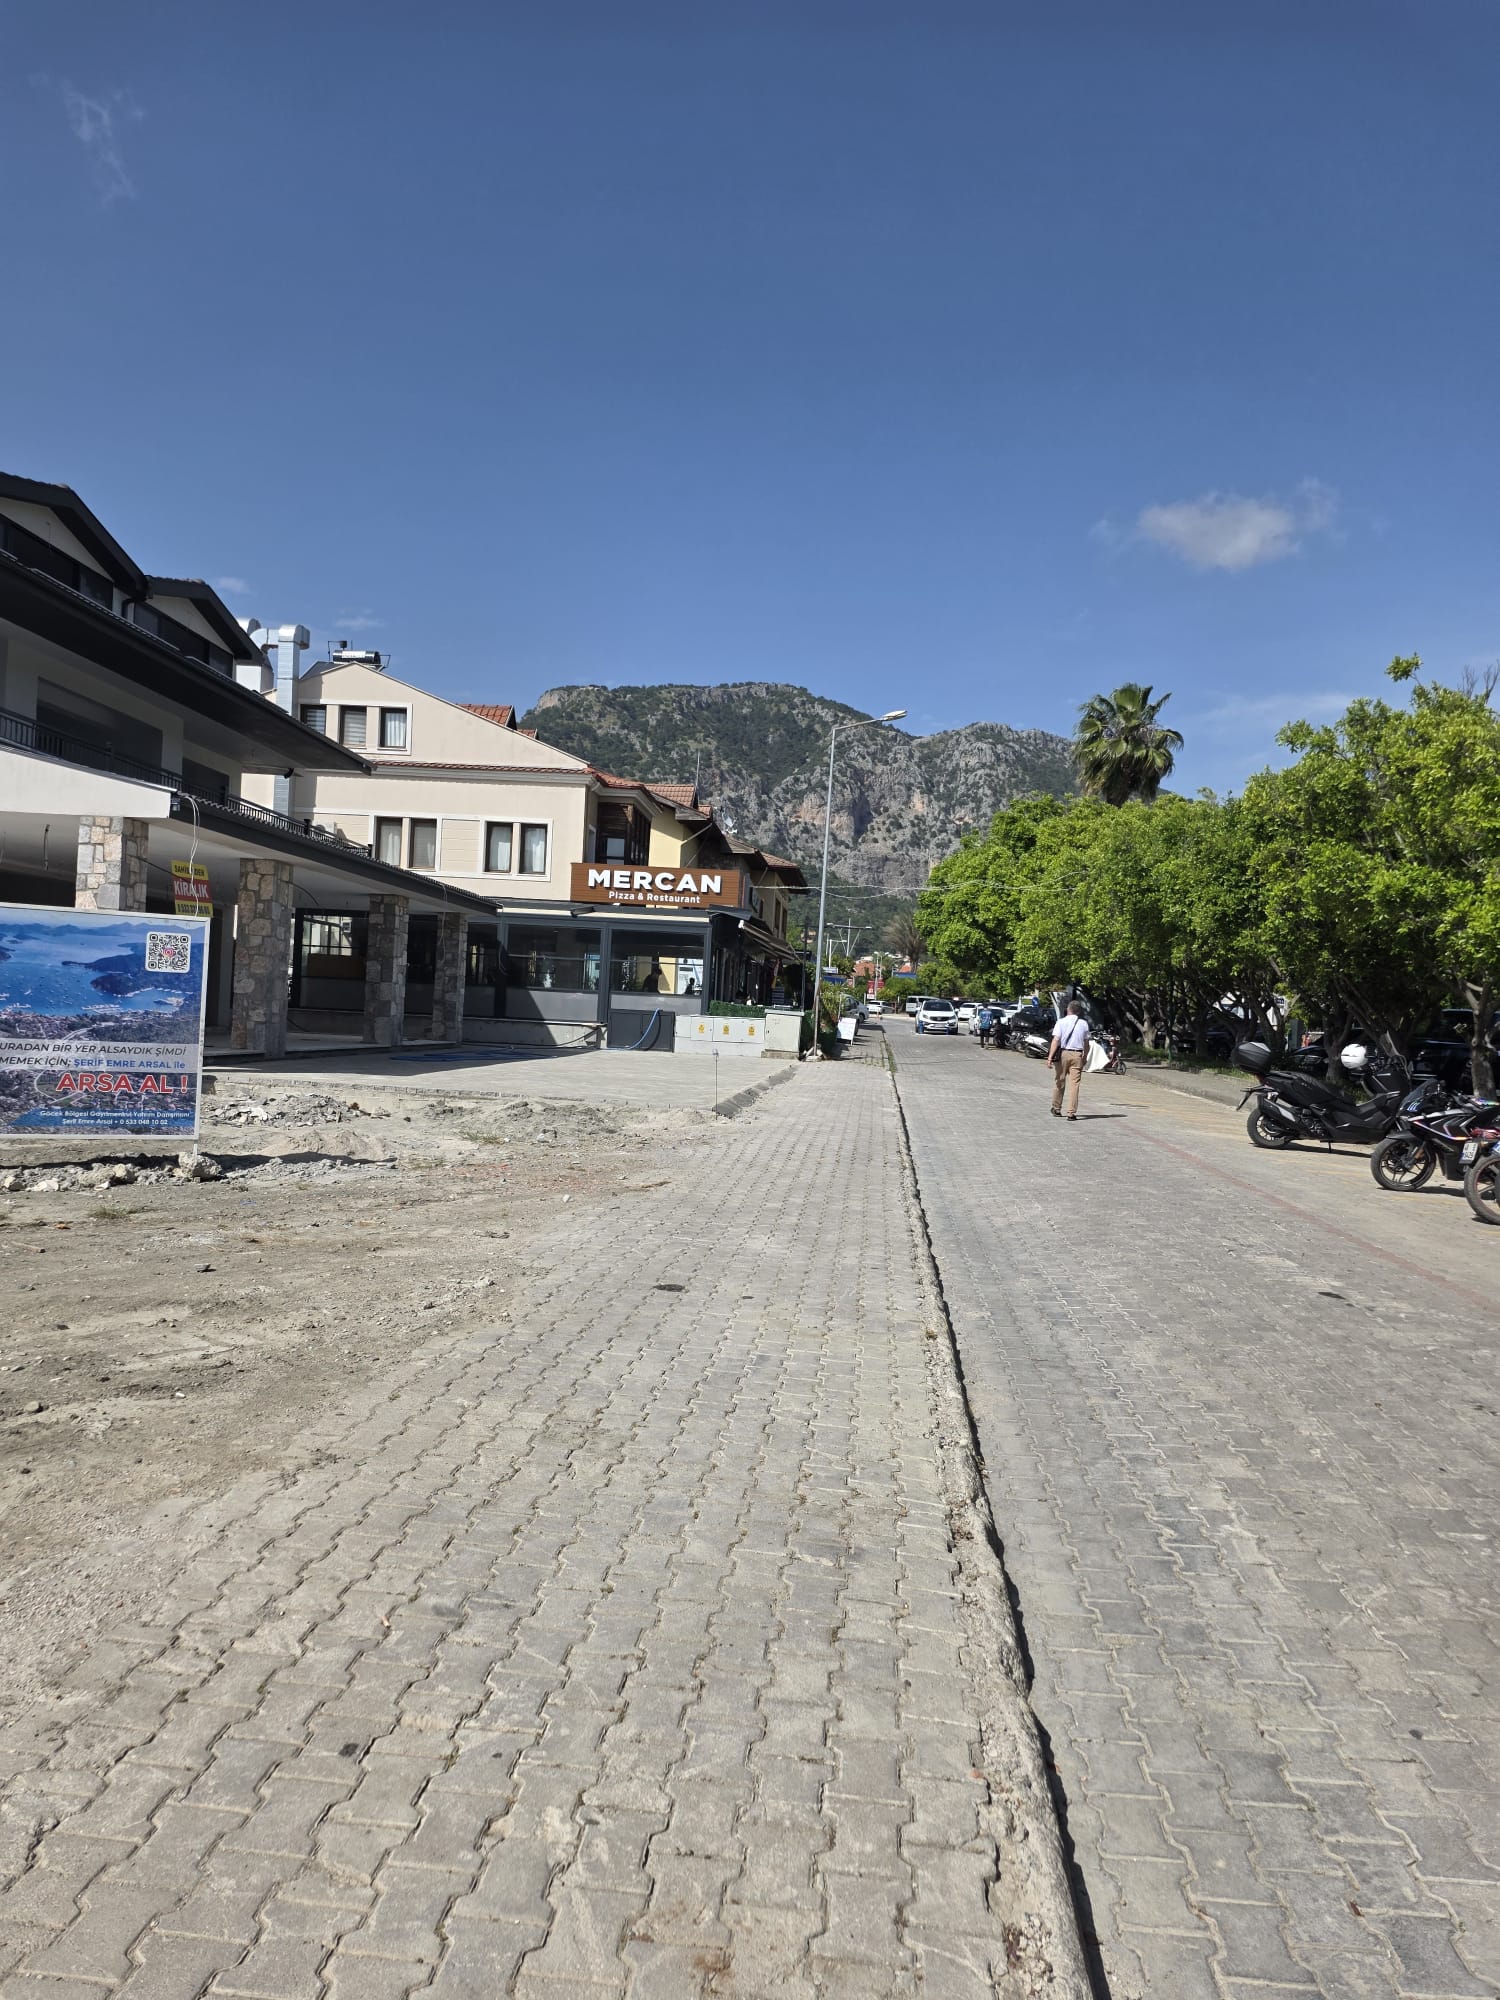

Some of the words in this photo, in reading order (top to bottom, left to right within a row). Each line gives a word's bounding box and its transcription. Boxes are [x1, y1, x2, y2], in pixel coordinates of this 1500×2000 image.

[174, 879, 209, 898] KİRALIK
[587, 868, 722, 894] MERCAN
[608, 890, 635, 900] Pizza
[637, 891, 644, 900] &
[647, 893, 701, 904] Restaurant
[52, 1043, 72, 1052] BİR
[75, 1044, 97, 1053] YER
[98, 1045, 153, 1055] ALSAYDIK
[155, 1046, 187, 1057] ŞİMDİ
[44, 1056, 72, 1068] İÇİN;
[73, 1057, 105, 1068] ŞERİF
[106, 1059, 136, 1068] EMRE
[138, 1060, 172, 1069] ARSAL
[55, 1072, 134, 1093] ARSA
[139, 1074, 174, 1094] AL
